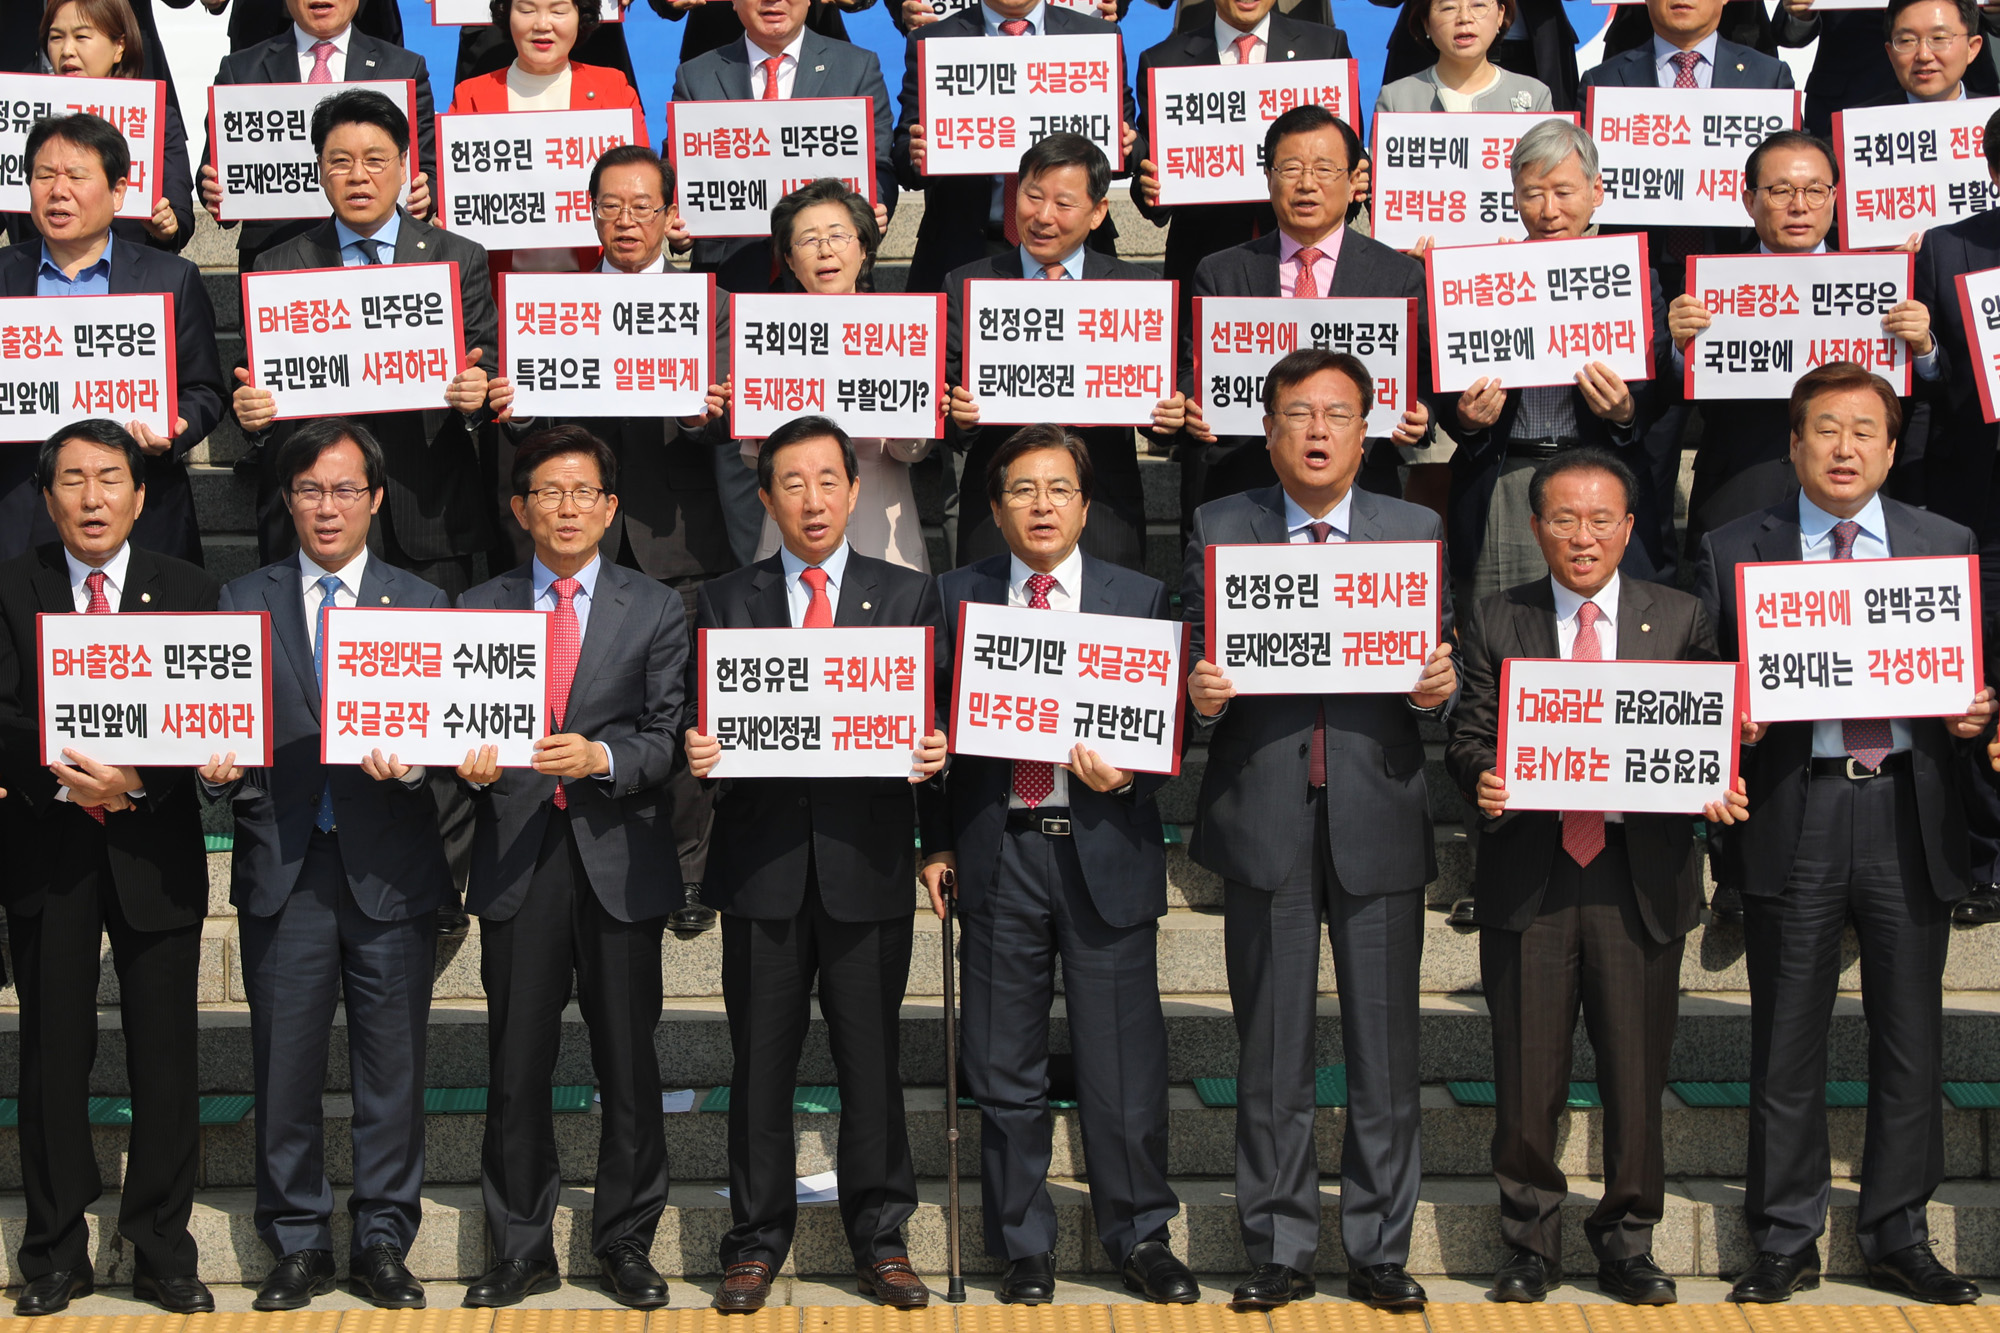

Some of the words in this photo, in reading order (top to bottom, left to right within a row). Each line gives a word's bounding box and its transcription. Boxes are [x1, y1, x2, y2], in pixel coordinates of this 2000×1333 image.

[936, 63, 1016, 96] 국민기만
[1028, 61, 1109, 93] 댓글공작
[1166, 91, 1246, 125] 국회의원
[224, 110, 306, 142] 헌정유린
[684, 128, 770, 159] BH출장소
[781, 125, 858, 157] 민주당은
[936, 117, 1016, 149] 민주당을
[1601, 114, 1690, 146] BH출장소
[451, 139, 532, 172] 헌정유린
[1167, 145, 1244, 179] 독재정치
[1386, 137, 1468, 169] 입법부에
[1854, 130, 1937, 167] 국회의원
[227, 162, 320, 194] 문재인정권
[1602, 168, 1683, 200] 국민앞에
[454, 192, 545, 225] 문재인정권
[687, 180, 767, 212] 국민앞에
[1385, 190, 1466, 222] 권력남용
[1856, 185, 1936, 222] 독재정치
[1443, 271, 1536, 306] BH출장소
[1548, 264, 1631, 301] 민주당은
[1704, 284, 1799, 317] BH출장소
[1812, 282, 1898, 316] 민주당은
[259, 299, 351, 333] BH출장소
[362, 293, 443, 329] 민주당은
[516, 302, 601, 335] 댓글공작
[613, 302, 699, 335] 여론조작
[979, 308, 1063, 341] 헌정유린
[1078, 309, 1163, 342] 국회사찰
[0, 326, 63, 359] 출장소
[74, 323, 156, 357] 민주당은
[745, 322, 828, 355] 국회의원
[842, 323, 928, 357] 전원사찰
[1210, 322, 1297, 354] 선관위에
[1448, 327, 1534, 364] 국민앞에
[1548, 320, 1636, 358] 사죄하라
[264, 354, 349, 391] 국민앞에
[362, 348, 448, 386] 사죄하라
[1705, 340, 1793, 373] 국민앞에
[516, 358, 600, 392] 특검으로
[614, 358, 698, 391] 일벌백계
[979, 364, 1074, 397] 문재인정권
[1085, 364, 1162, 398] 규탄한다
[72, 379, 159, 414] 사죄하라
[744, 378, 824, 411] 독재정치
[837, 379, 929, 412] 부활인가?
[1226, 574, 1318, 609] 헌정유린
[1334, 572, 1428, 608] 국회사찰
[1756, 590, 1851, 628] 선관위에
[1865, 585, 1961, 624] 압박공작
[53, 644, 152, 679] BH출장소
[164, 644, 252, 679] 민주당은
[338, 641, 442, 677] 국정원댓글
[453, 643, 536, 679] 수사하듯
[974, 634, 1066, 675] 국민기만
[1078, 643, 1171, 686] 댓글공작
[1226, 632, 1330, 667] 문재인정권
[1342, 631, 1428, 666] 규탄한다
[717, 657, 808, 692] 헌정유린
[824, 656, 916, 692] 국회사찰
[1759, 652, 1853, 690] 청와대는
[1868, 646, 1964, 685] 각성하라
[56, 704, 147, 738] 국민앞에
[161, 703, 254, 738] 사죄하라
[337, 701, 429, 738] 댓글공작
[443, 703, 535, 739] 수사하라
[969, 692, 1059, 733] 민주당을
[1074, 702, 1165, 745] 규탄한다
[1517, 687, 1604, 723] 규탄한다
[1615, 690, 1723, 725] 문재인정권
[717, 716, 820, 750] 문재인정권
[832, 715, 915, 750] 규탄한다
[1515, 746, 1609, 782] 국회사찰
[1626, 749, 1720, 785] 헌정유린
